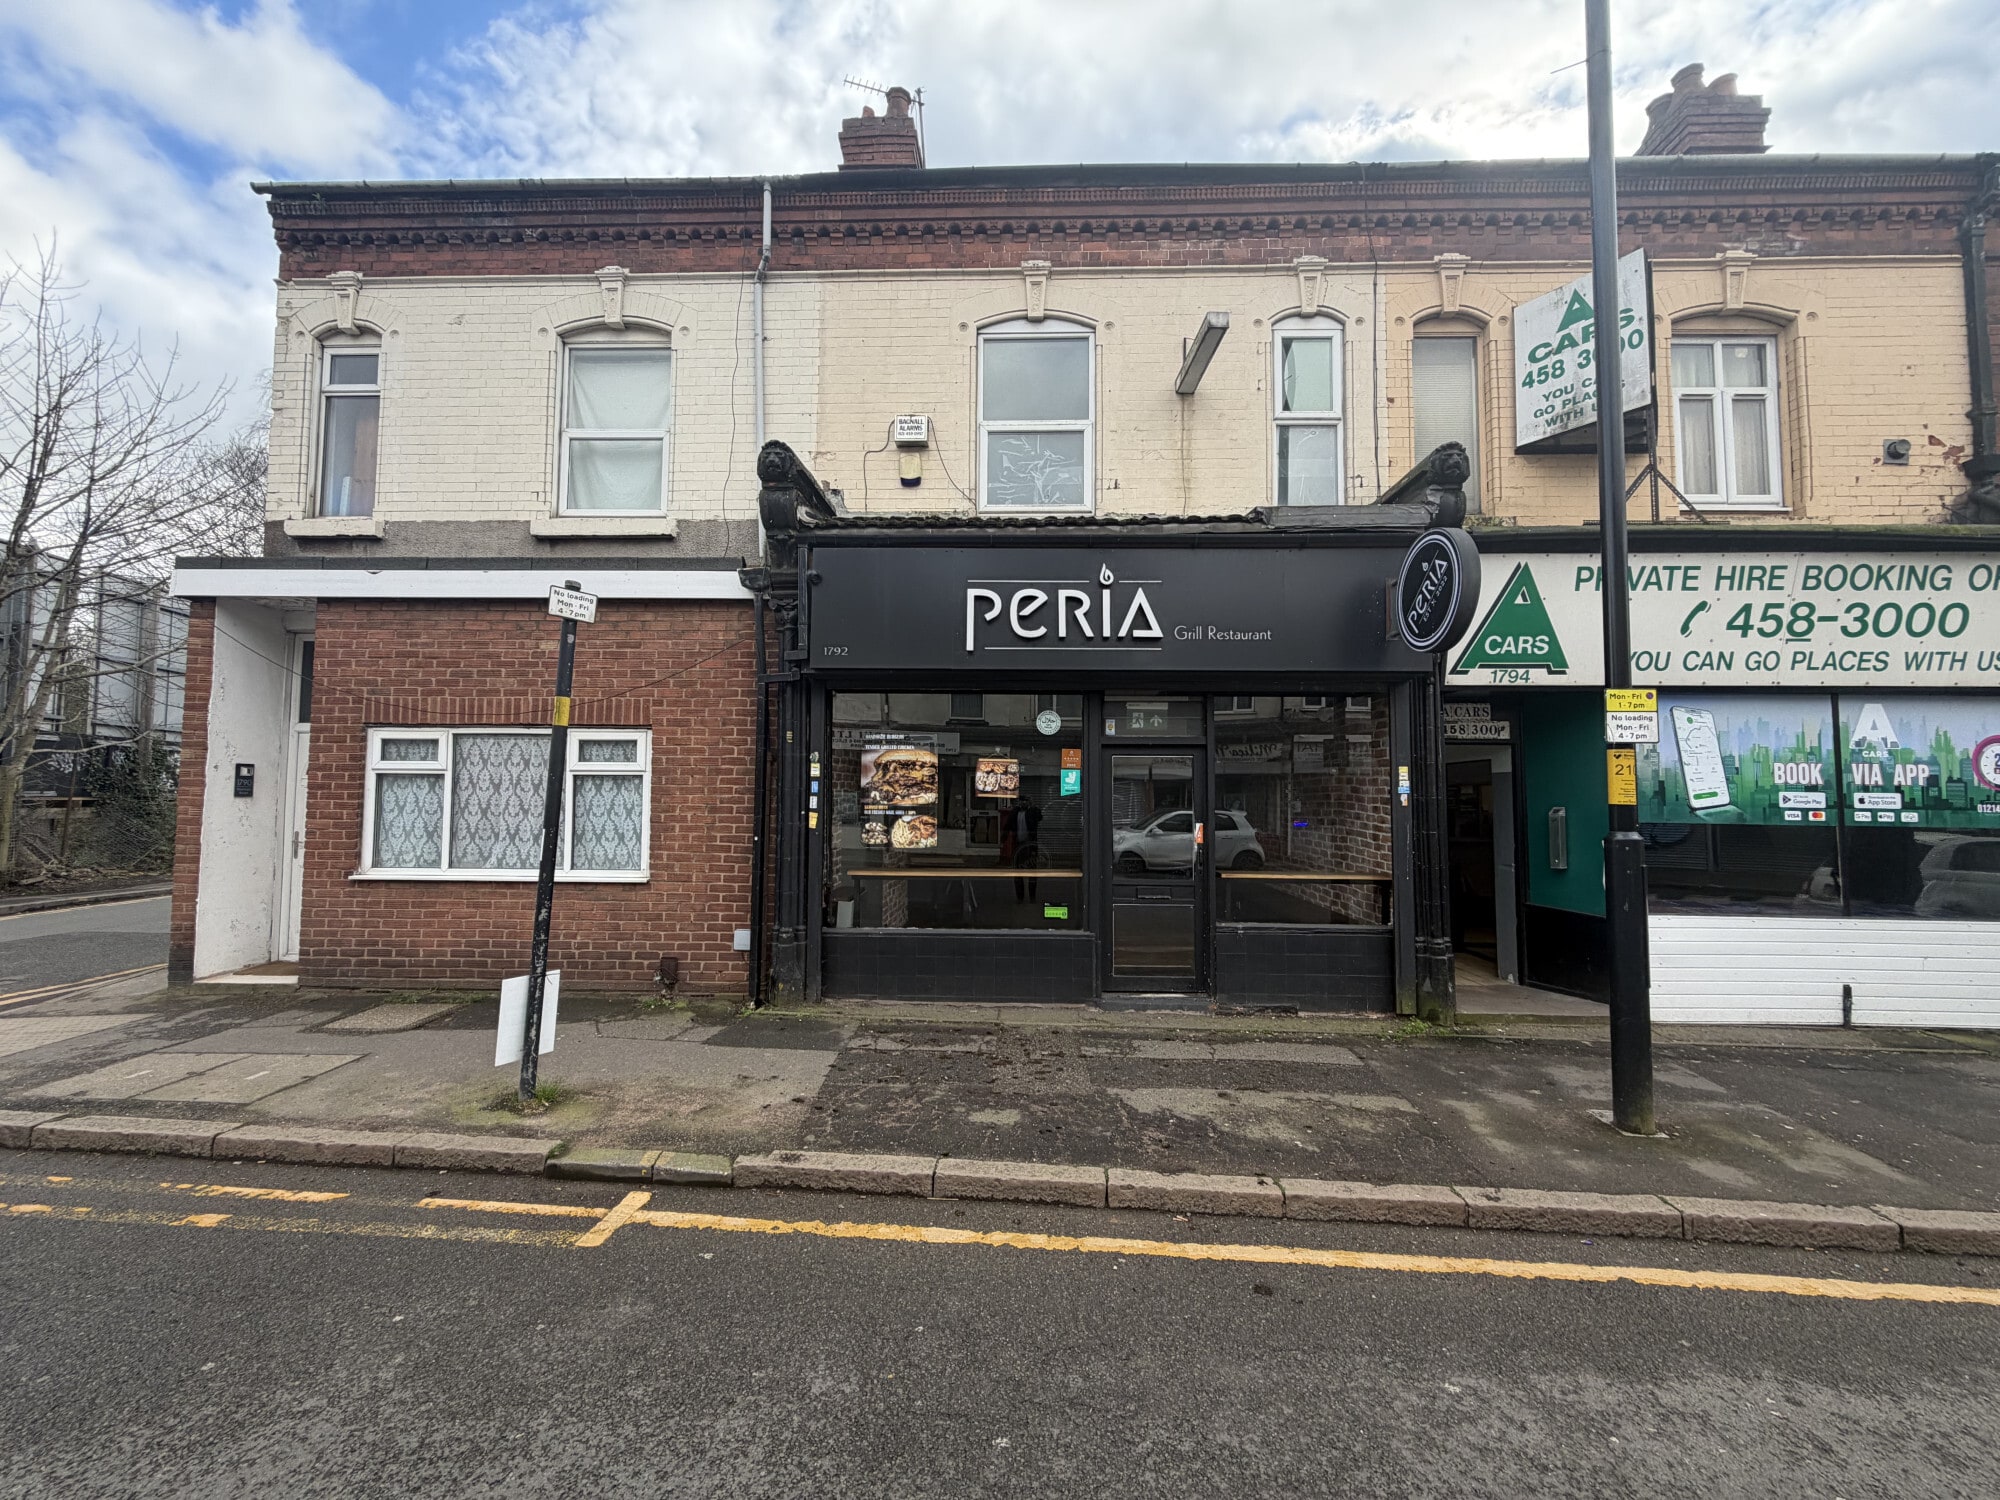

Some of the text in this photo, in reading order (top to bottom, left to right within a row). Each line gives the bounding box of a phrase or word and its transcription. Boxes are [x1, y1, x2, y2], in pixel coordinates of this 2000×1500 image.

[1521, 328, 1644, 389] 458 30
[1542, 383, 1575, 403] YOU
[1533, 404, 1556, 419] GO
[1545, 407, 1585, 428] WITH
[1574, 565, 1702, 592] PVATE
[1714, 564, 1789, 592] HIRE
[1801, 563, 1953, 592] BOOKING
[1436, 578, 1448, 597] 2022
[557, 599, 573, 608] Mon
[567, 592, 594, 604] loading
[1726, 601, 1970, 639] 458-3000
[1174, 625, 1203, 641] Grill
[1208, 625, 1273, 641] Restaurant
[823, 646, 849, 656] 1792
[1484, 634, 1550, 656] CARS
[1683, 650, 1735, 672] CAN
[1745, 650, 1781, 672] GO
[1790, 650, 1890, 672] PLACES
[1904, 650, 1968, 672] WITH
[1490, 668, 1531, 684] 1794
[1454, 706, 1490, 718] CARS
[1849, 703, 1901, 749] A
[1615, 764, 1635, 776] 21
[1773, 762, 1930, 786] BOOK VIA APP
